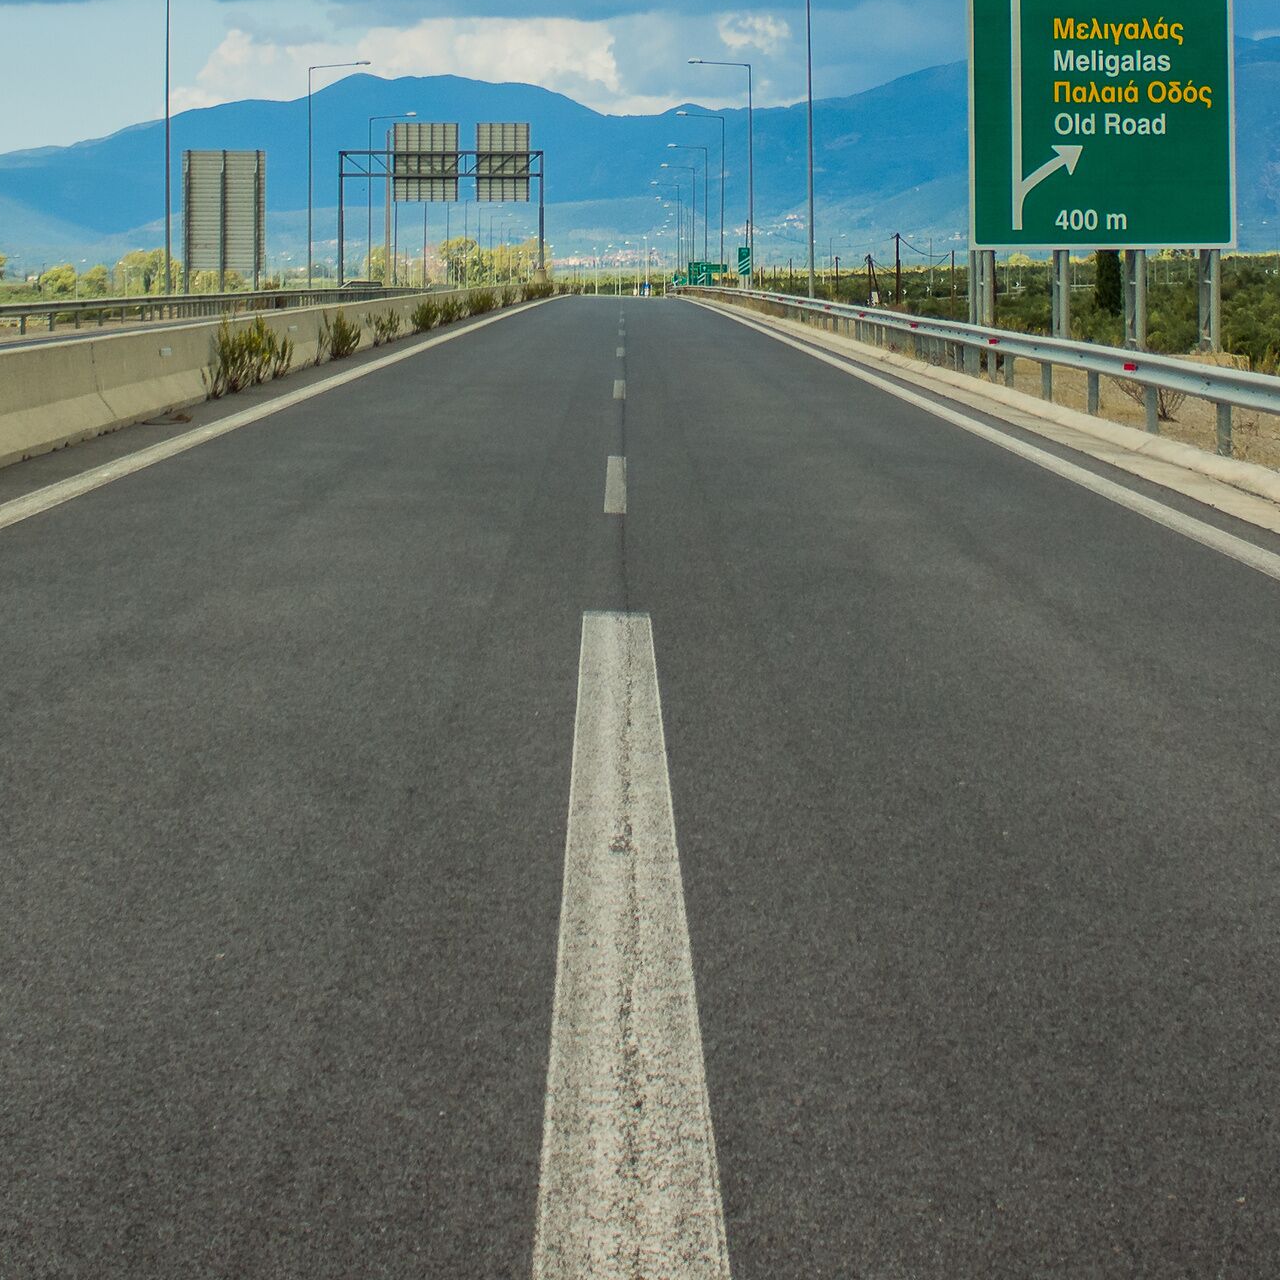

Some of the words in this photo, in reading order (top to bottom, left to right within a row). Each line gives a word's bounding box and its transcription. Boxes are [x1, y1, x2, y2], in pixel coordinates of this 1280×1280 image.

[1053, 16, 1184, 46] Μελιγαλάς
[1053, 49, 1171, 78] Meligalas
[1053, 79, 1139, 104] Παλαιά
[1147, 79, 1213, 109] Οδός
[1054, 112, 1096, 136] Old
[1104, 112, 1166, 135] Road
[1055, 209, 1099, 231] 400
[1106, 213, 1127, 230] m
